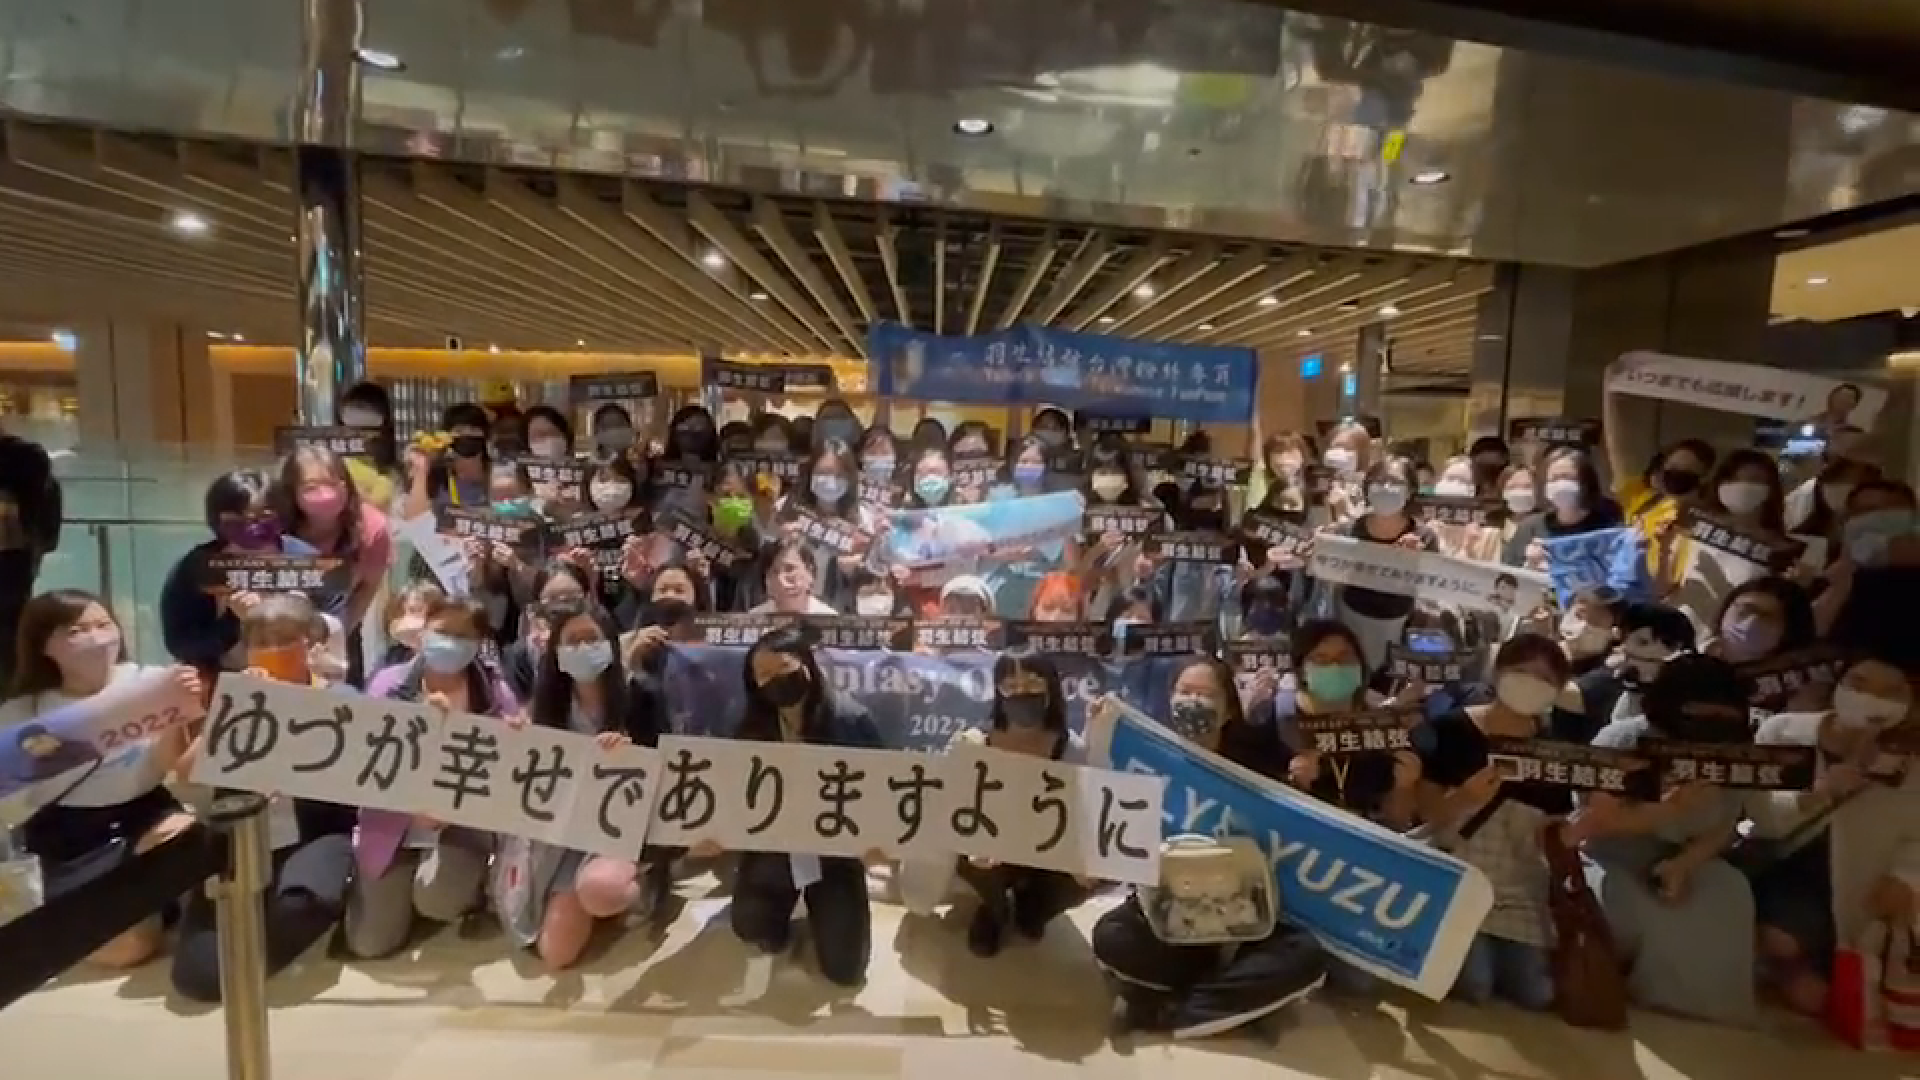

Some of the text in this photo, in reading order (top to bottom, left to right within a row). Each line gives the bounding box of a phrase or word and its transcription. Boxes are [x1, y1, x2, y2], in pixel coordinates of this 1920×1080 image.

[225, 569, 325, 589] 羽生結弦
[100, 706, 188, 750] 2022
[1315, 729, 1411, 753] 羽生結弦
[206, 690, 1153, 863] ゆづが幸せでありますように
[1671, 758, 1784, 785] 羽生結弦
[1268, 829, 1431, 930] YUZU
